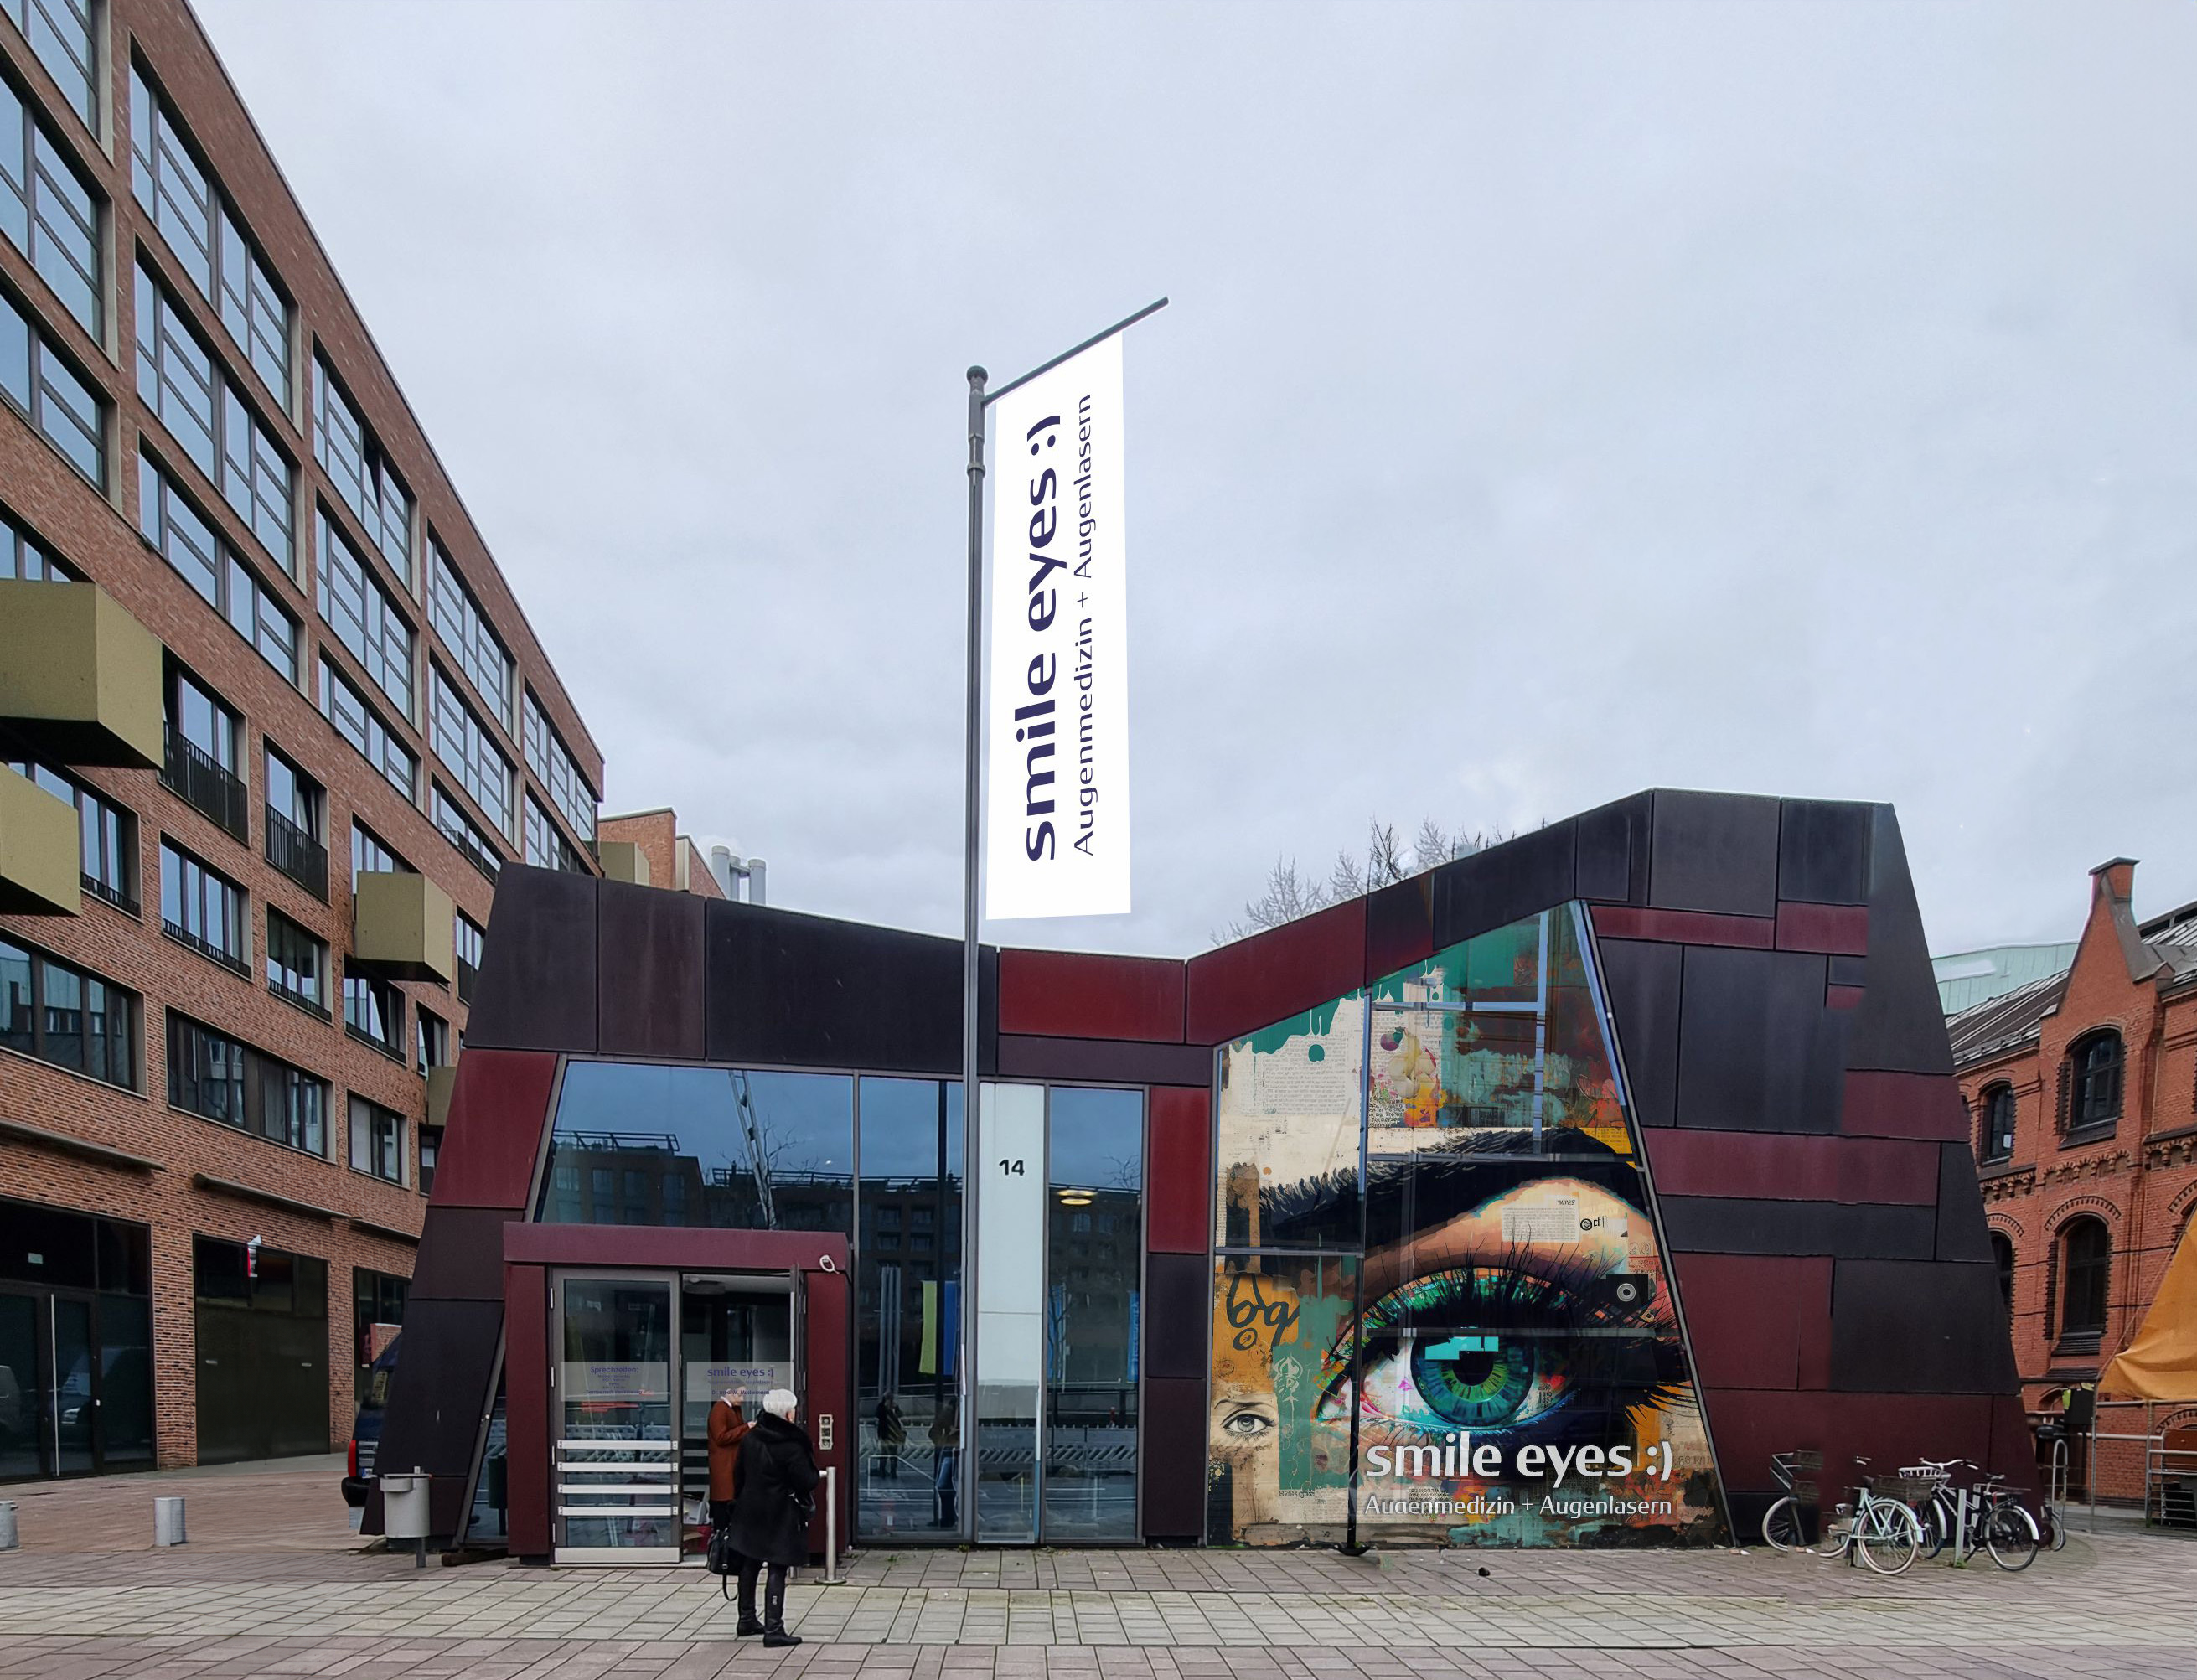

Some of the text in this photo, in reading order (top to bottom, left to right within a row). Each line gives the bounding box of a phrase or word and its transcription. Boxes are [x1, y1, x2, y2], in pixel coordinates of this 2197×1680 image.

[1028, 468, 1067, 632] eyes
[1073, 394, 1098, 856] Augenmedizin + Augenlasern
[1014, 652, 1057, 861] smile
[999, 1159, 1025, 1176] 14
[590, 1366, 638, 1374] Sprechzeiten:
[706, 1366, 737, 1377] smile
[739, 1368, 765, 1379] eyes
[1366, 1430, 1502, 1477] smile
[1517, 1445, 1632, 1488] eyes
[1522, 1496, 1534, 1512] +
[1539, 1495, 1672, 1519] Augenlasern
